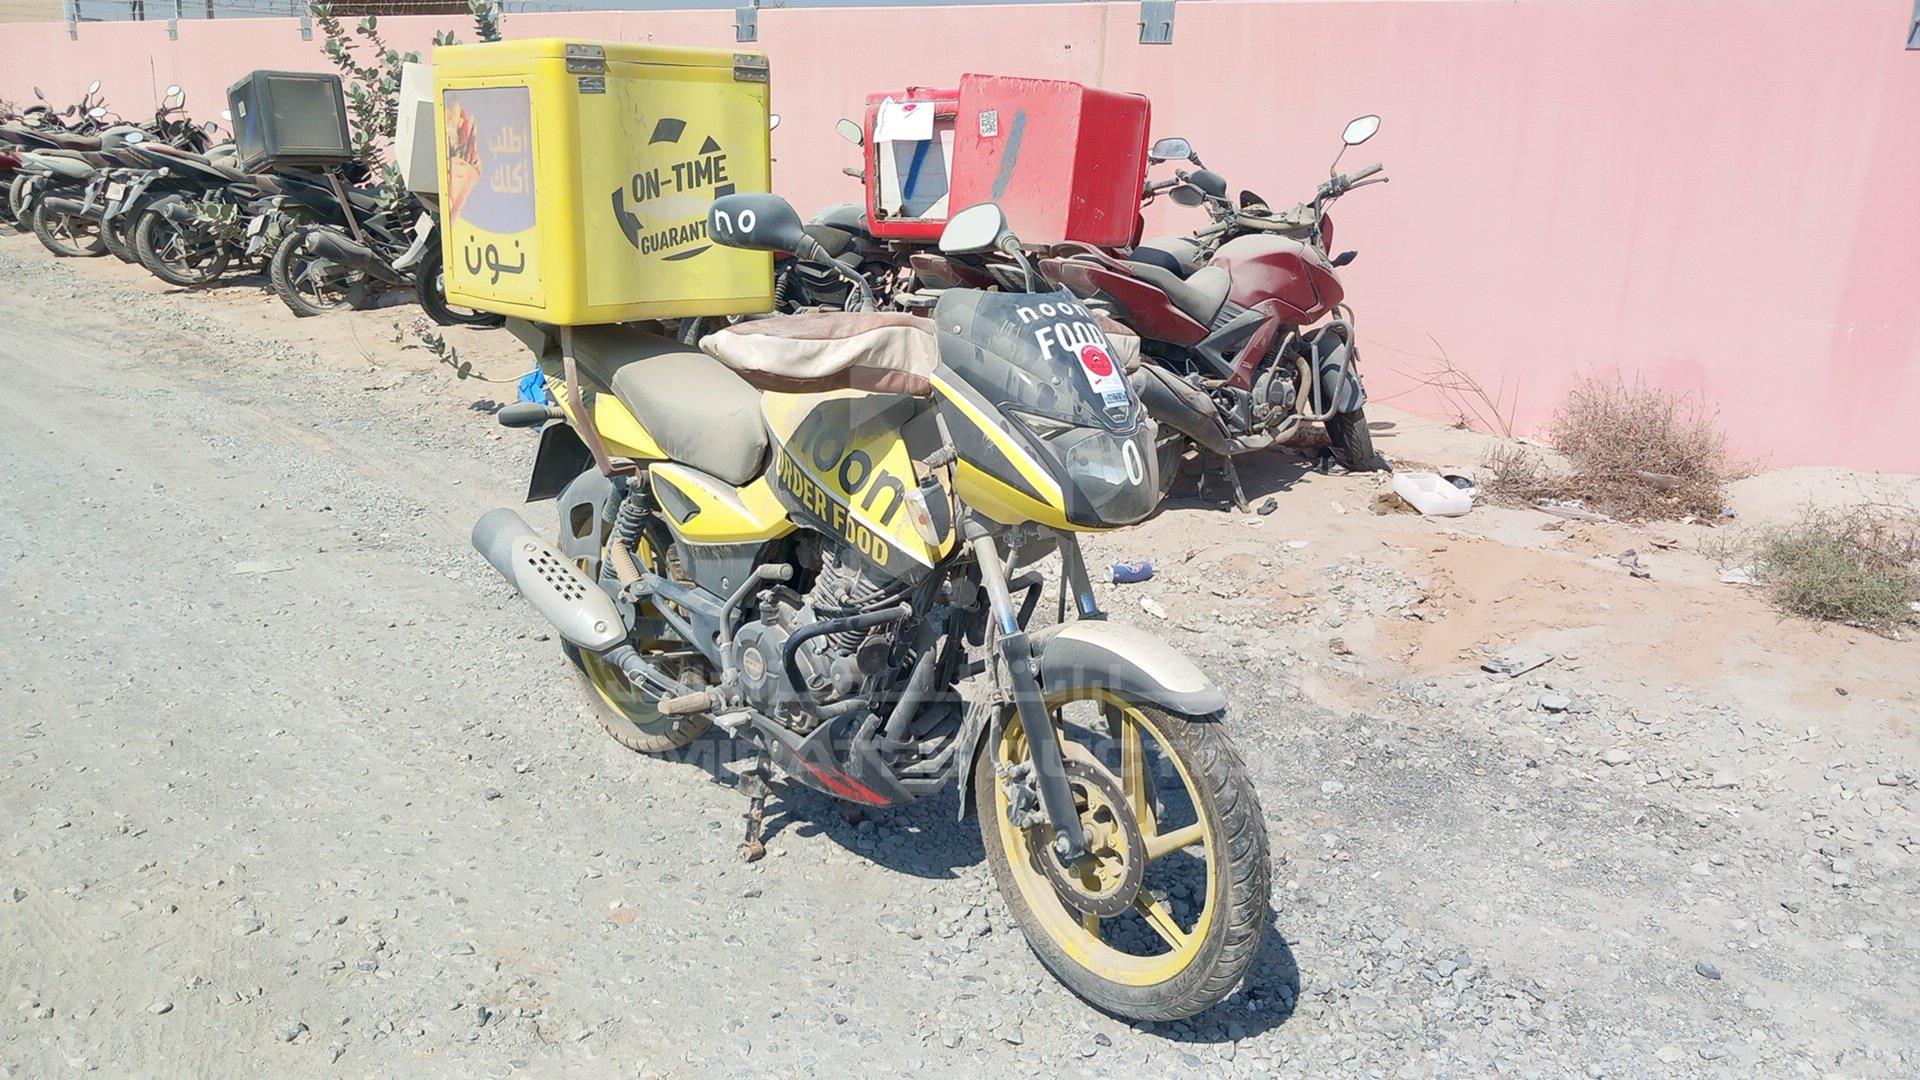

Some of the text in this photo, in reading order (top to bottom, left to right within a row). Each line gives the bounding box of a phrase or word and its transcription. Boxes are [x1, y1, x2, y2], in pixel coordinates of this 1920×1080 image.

[632, 154, 728, 203] ON-TIME
[465, 235, 525, 285] نون
[641, 219, 708, 255] GUARANT
[1017, 302, 1090, 324] noon
[776, 445, 890, 567] ORDER FOOD
